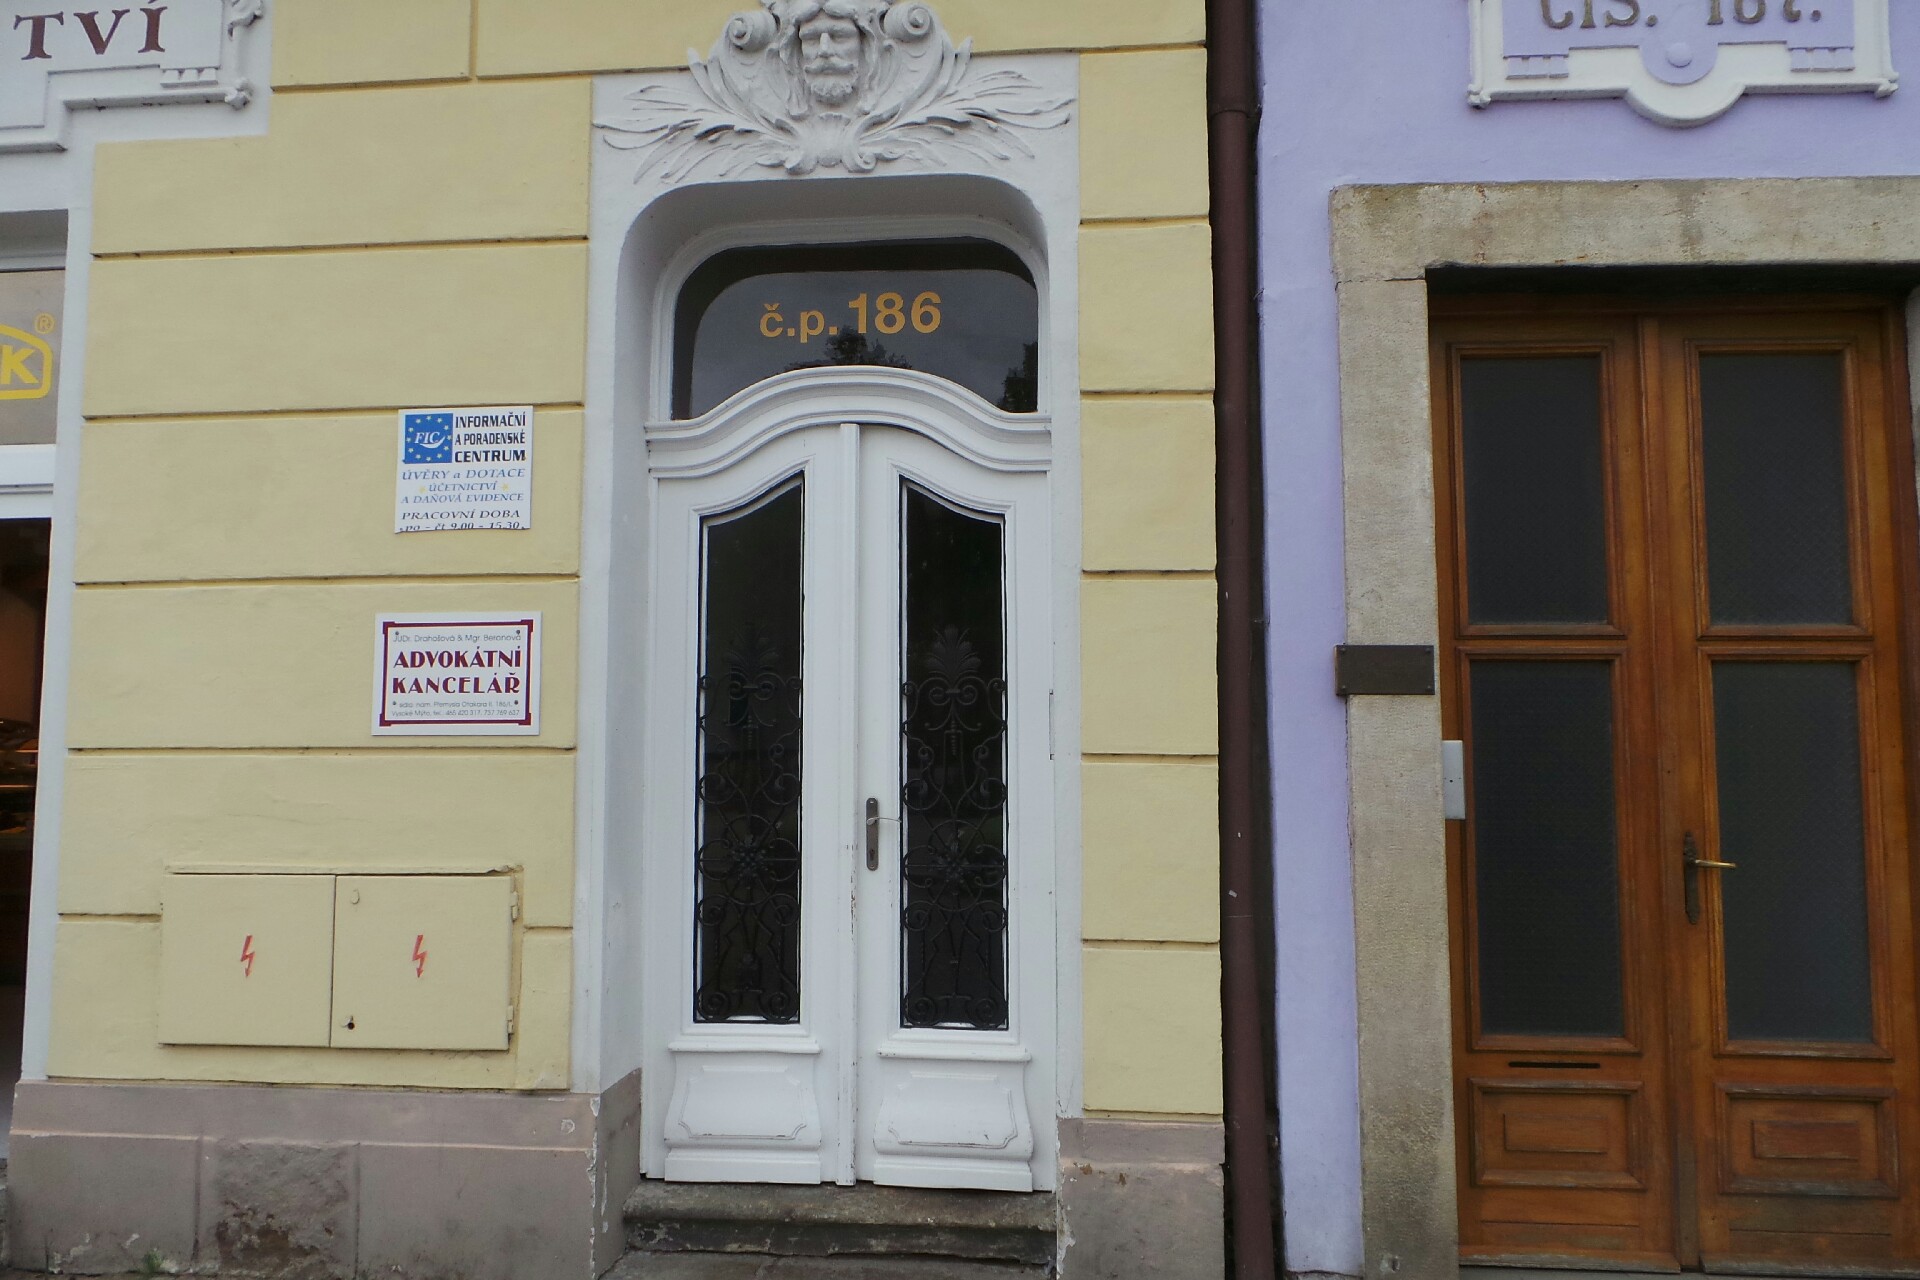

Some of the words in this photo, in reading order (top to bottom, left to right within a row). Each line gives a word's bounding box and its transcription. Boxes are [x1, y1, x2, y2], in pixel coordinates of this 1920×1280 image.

[759, 302, 839, 344] č.p.
[848, 291, 942, 334] 186
[455, 411, 526, 429] INFORMAČNÍ
[414, 431, 441, 444] FIC
[454, 433, 462, 446] A
[464, 429, 526, 446] PORADENSKÉ
[454, 449, 526, 463] CENTRUM
[402, 468, 450, 480] ÚVĚRY
[466, 468, 526, 479] DOTACE
[428, 480, 498, 492] ÚČETNICTVÍ
[400, 494, 409, 504] A
[413, 492, 462, 504] DAŇOVÁ
[466, 492, 524, 503] EVIDENCE
[401, 508, 476, 520] PRACOVNÍ
[479, 509, 520, 519] DOBA
[393, 646, 521, 669] ADVOKÁTNÍ
[392, 672, 521, 694] KANCELÁŘ
